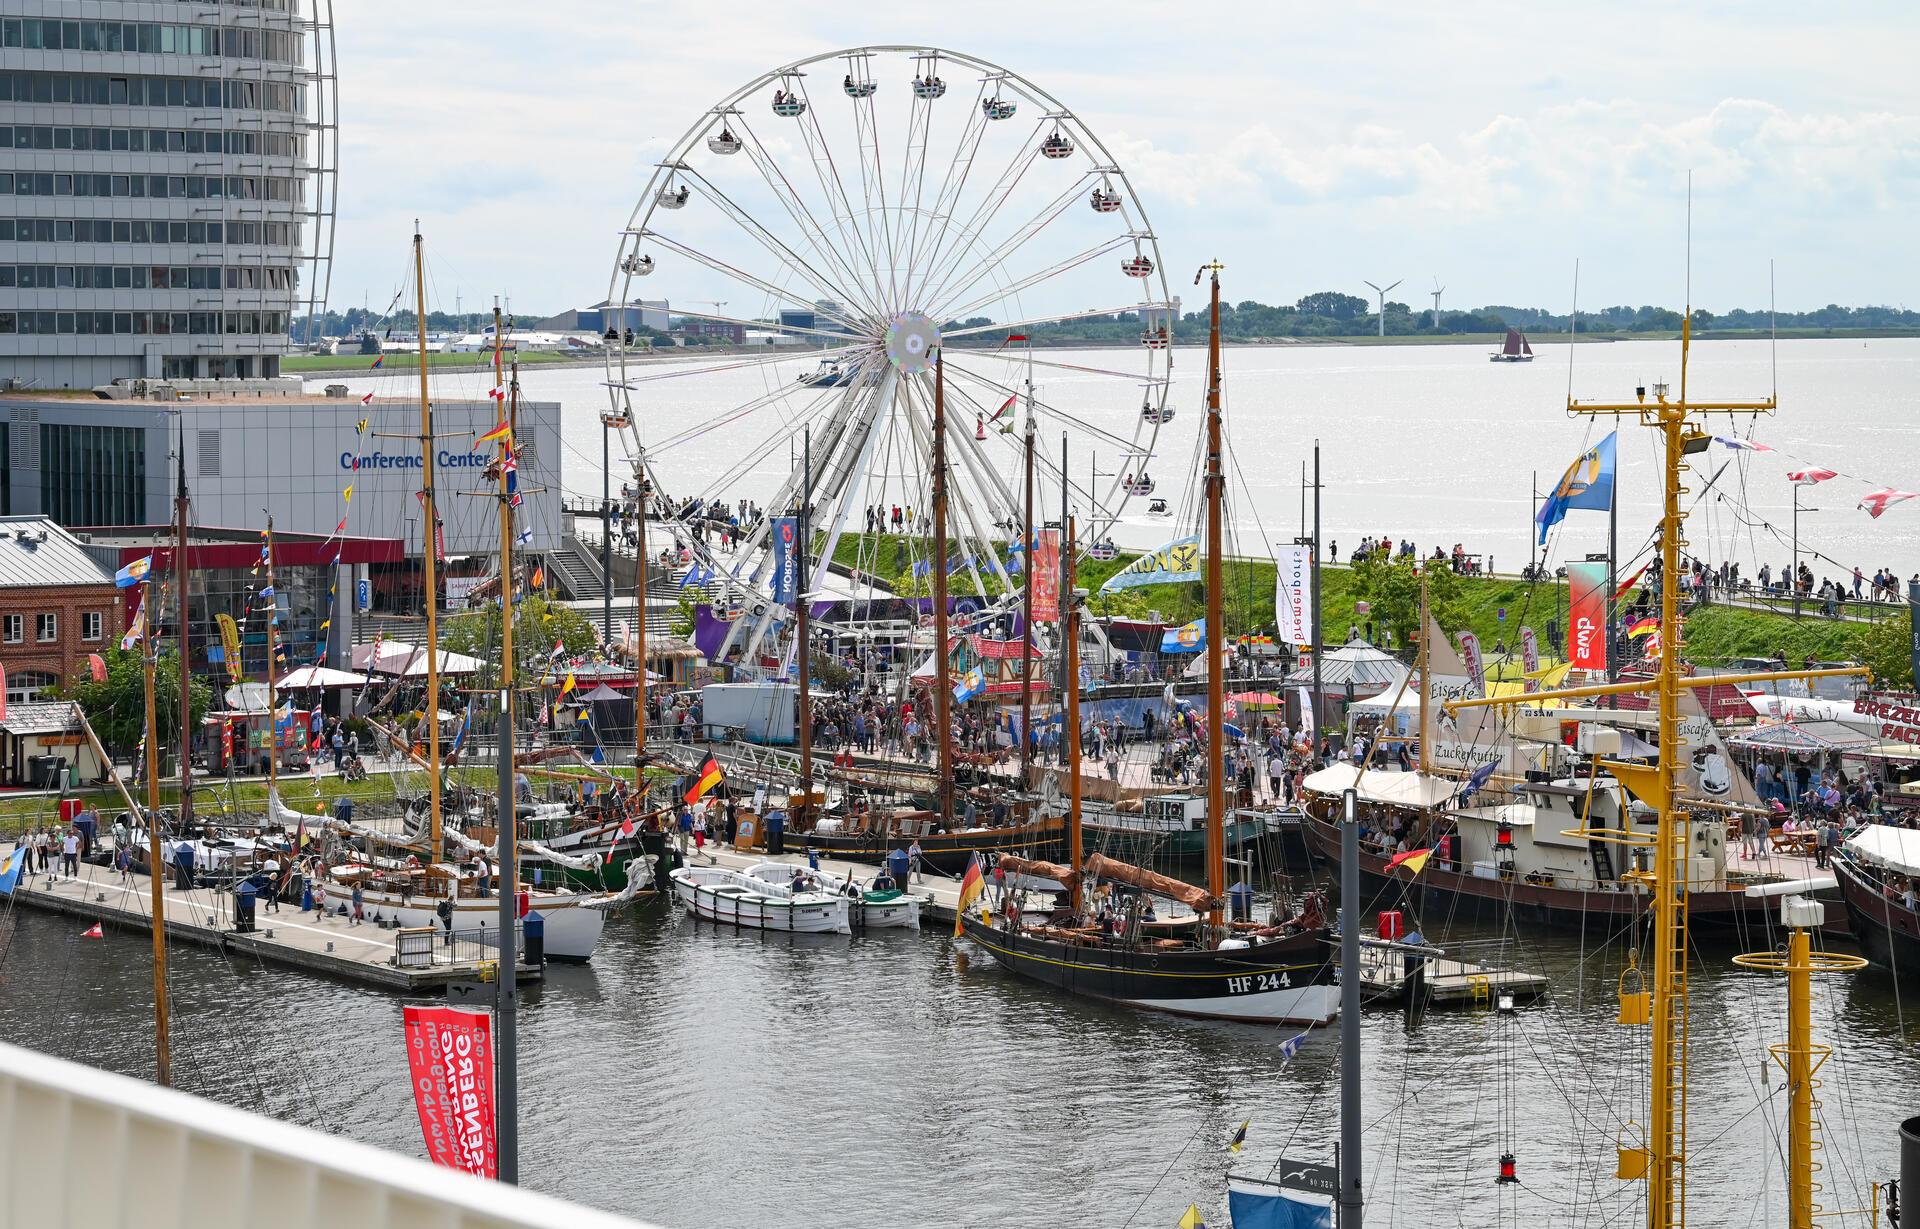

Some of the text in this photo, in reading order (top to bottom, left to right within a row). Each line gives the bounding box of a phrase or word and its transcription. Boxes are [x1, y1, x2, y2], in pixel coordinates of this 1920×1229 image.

[341, 451, 424, 469] Conferenc
[1300, 657, 1311, 667] B1
[1227, 971, 1291, 993] HF 244
